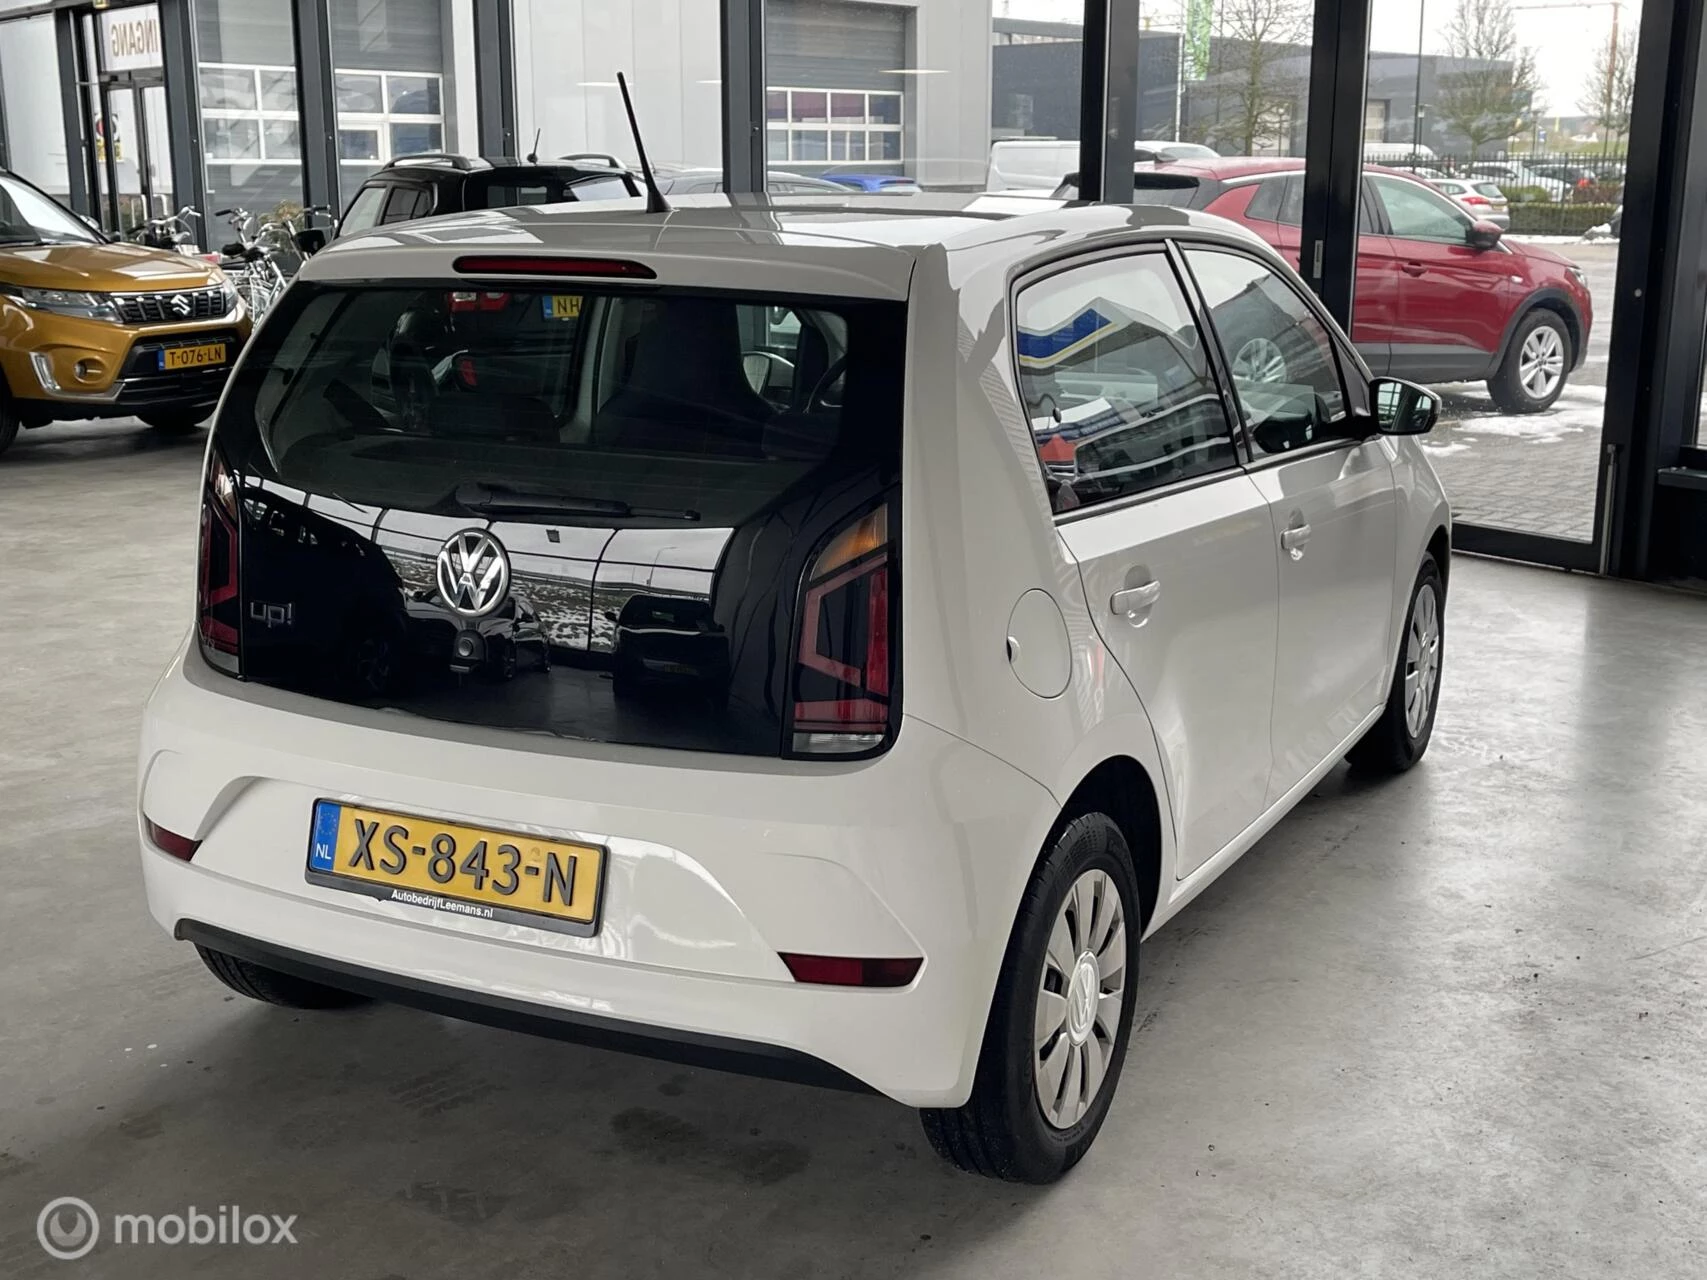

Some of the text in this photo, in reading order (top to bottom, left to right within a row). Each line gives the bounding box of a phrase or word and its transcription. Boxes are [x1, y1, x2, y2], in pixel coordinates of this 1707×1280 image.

[169, 346, 222, 366] T-076-LN
[249, 601, 292, 628] up!
[315, 843, 332, 861] NL
[348, 818, 578, 907] XS-843-N
[391, 889, 493, 919] AutobedrijfLeemans.nl
